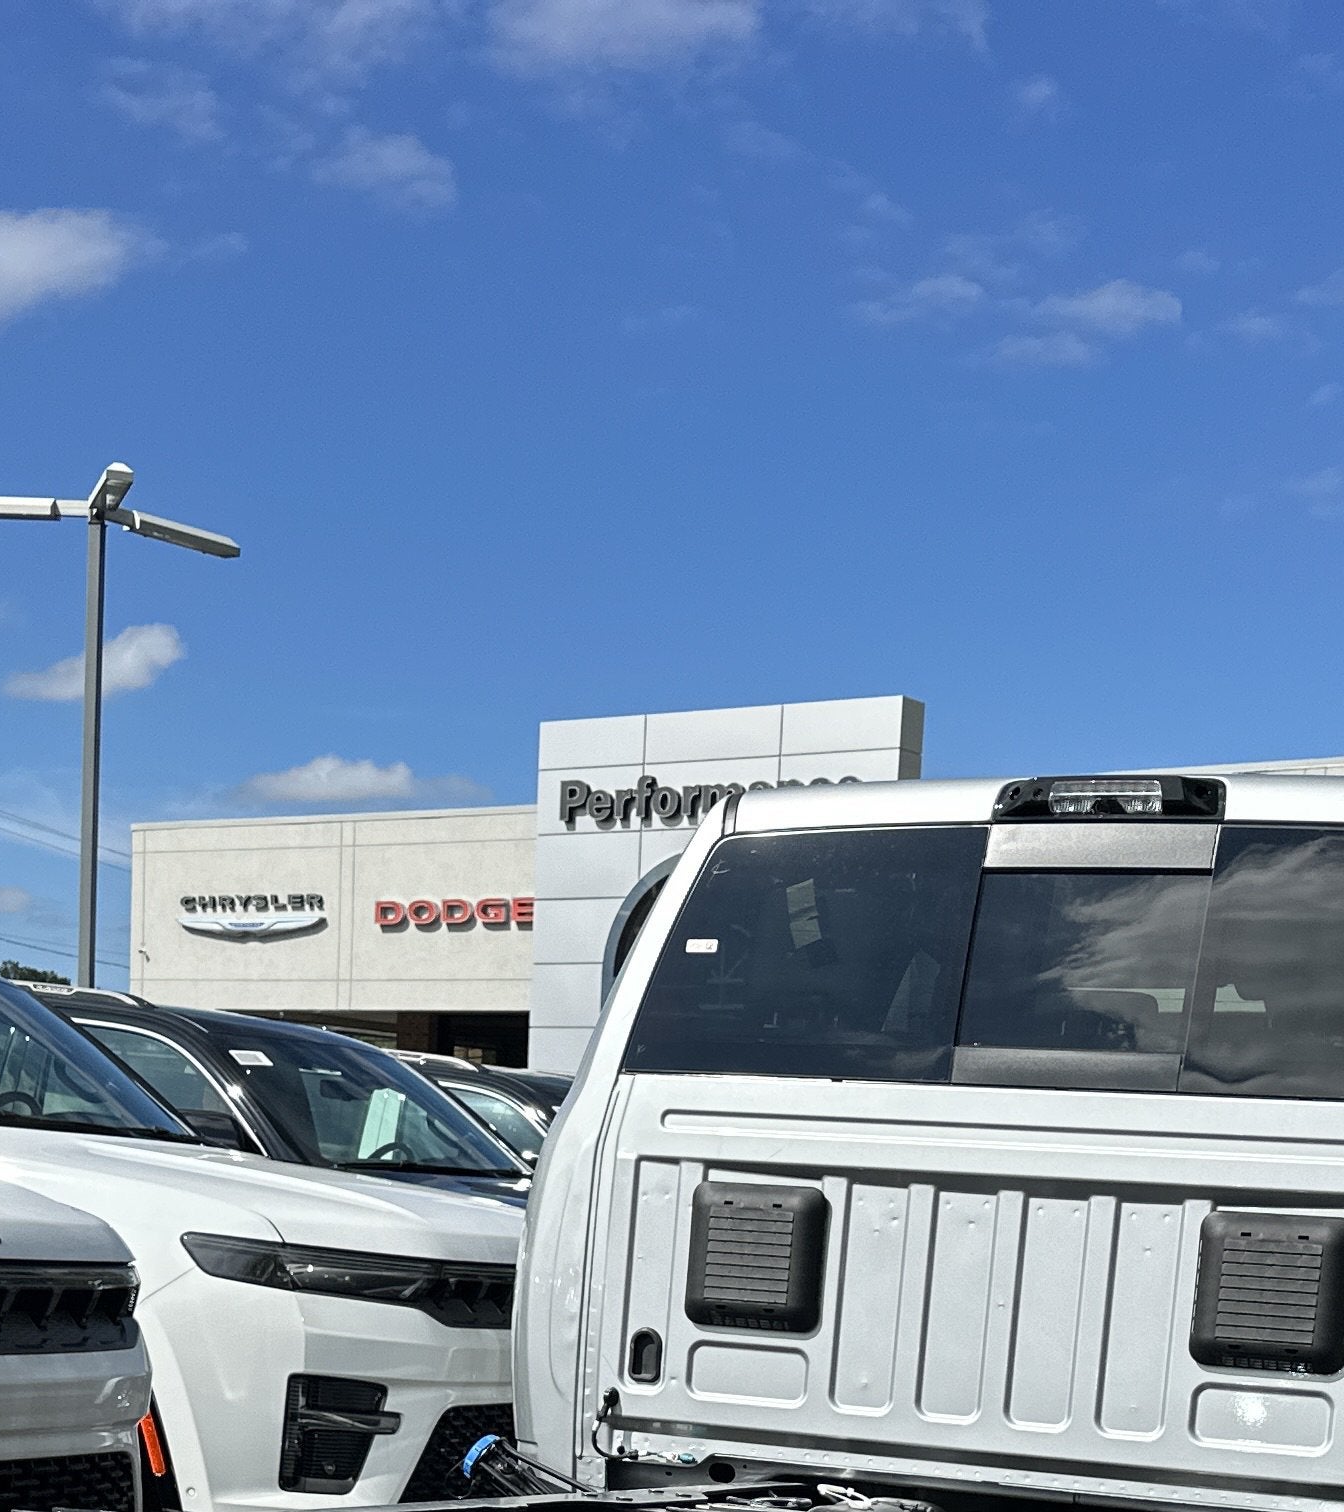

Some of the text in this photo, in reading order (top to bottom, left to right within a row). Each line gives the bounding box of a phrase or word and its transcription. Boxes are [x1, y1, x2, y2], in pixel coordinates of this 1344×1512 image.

[559, 774, 864, 824] Perform
[180, 893, 325, 912] CHRYSLER
[374, 897, 535, 926] DODGE
